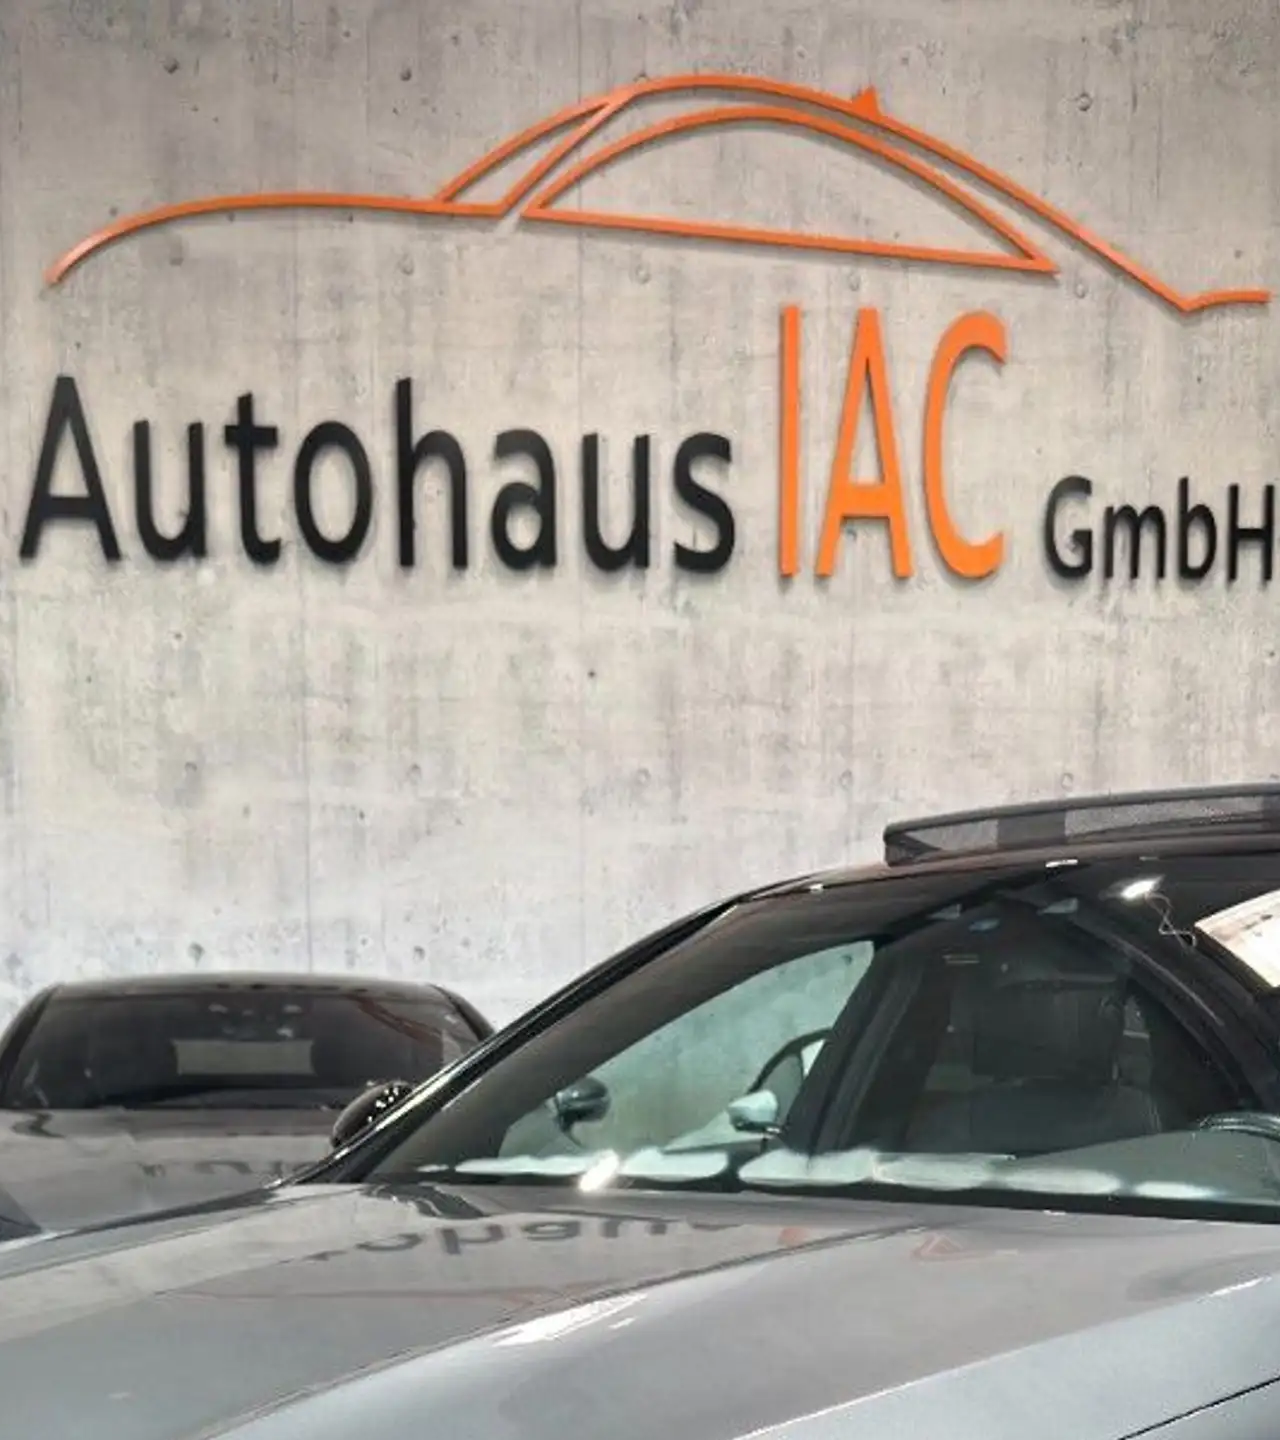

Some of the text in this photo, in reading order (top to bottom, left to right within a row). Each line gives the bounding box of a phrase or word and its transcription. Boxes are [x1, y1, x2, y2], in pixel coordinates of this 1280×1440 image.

[18, 304, 1274, 581] Autohaus IAC GmbH
